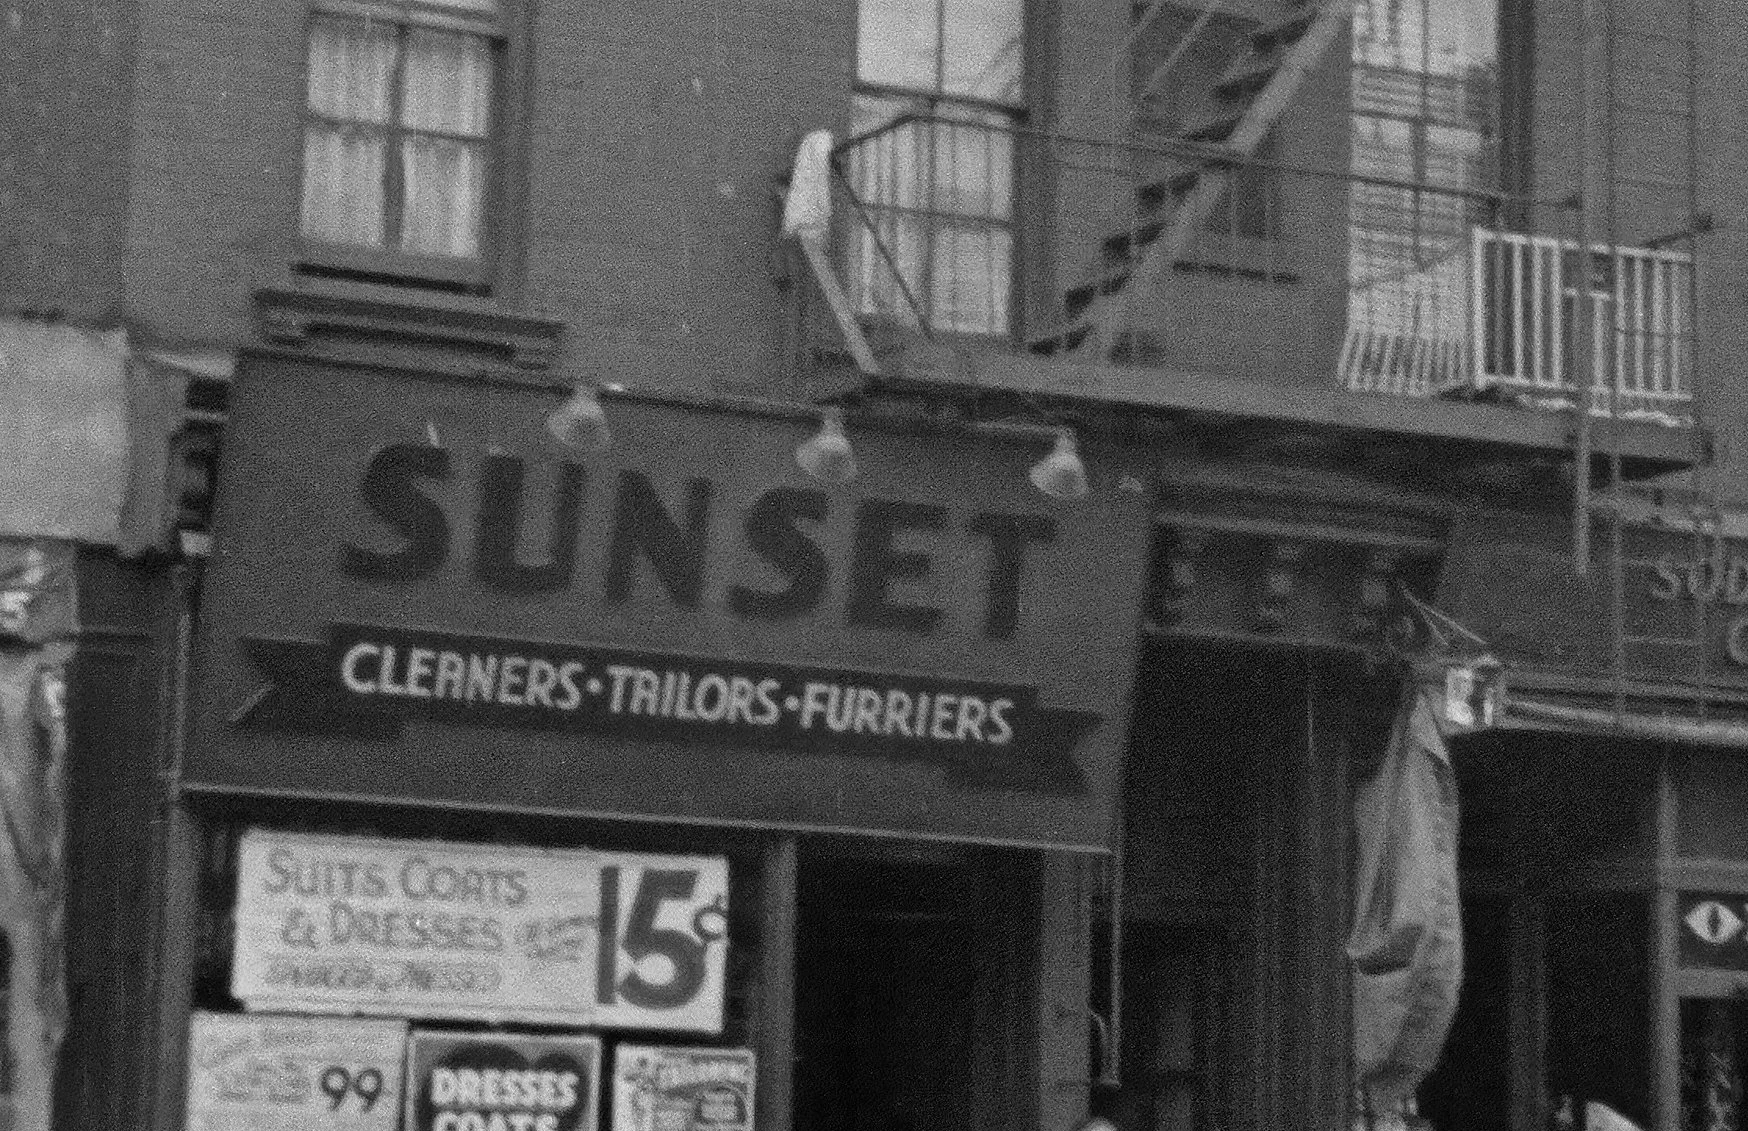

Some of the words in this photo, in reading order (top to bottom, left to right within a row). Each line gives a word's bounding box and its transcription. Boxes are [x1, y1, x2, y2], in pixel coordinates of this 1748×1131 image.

[339, 443, 1056, 639] SUNSET
[341, 642, 585, 712] CLEANERS
[606, 664, 783, 727] TAILORS
[799, 682, 1015, 746] FURRIERS
[400, 856, 527, 906] COATS
[329, 902, 503, 951] DRESSES
[431, 1067, 579, 1110] DRESSES
